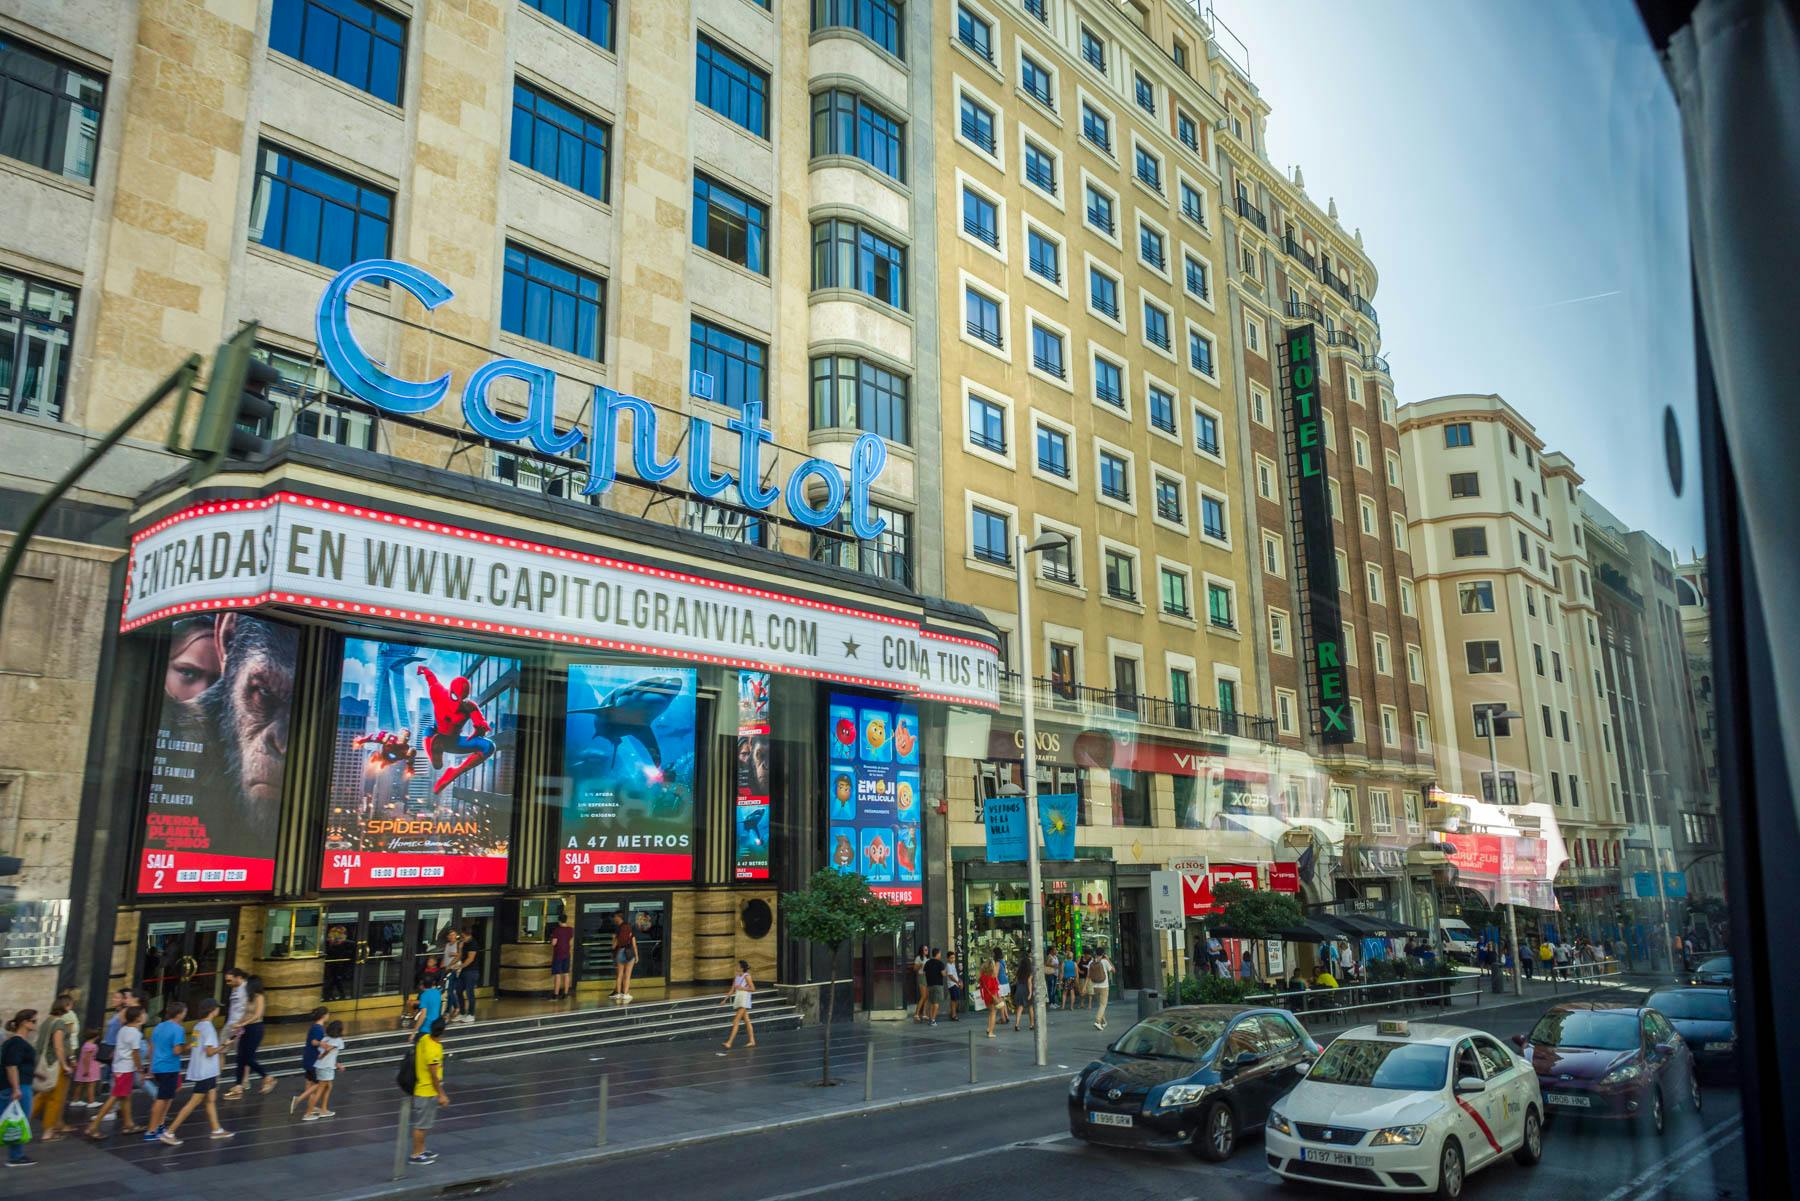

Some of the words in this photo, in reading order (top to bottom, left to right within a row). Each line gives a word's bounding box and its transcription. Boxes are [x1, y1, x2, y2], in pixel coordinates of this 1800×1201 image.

[315, 258, 888, 541] Capitol
[1291, 334, 1321, 478] HOTEL
[1317, 640, 1346, 732] REX
[139, 525, 272, 599] ENTRADAS
[287, 524, 346, 580] EN
[364, 538, 818, 657] WWW.CAPITOLGRANVIA.COM
[937, 651, 970, 686] TUS
[1015, 729, 1060, 751] GNOS
[164, 767, 195, 778] FAMILIA
[161, 794, 193, 805] PLANETA
[567, 835, 578, 848] A
[587, 836, 608, 848] 47
[617, 834, 689, 847] METROS
[147, 854, 174, 869] SALA
[333, 855, 361, 868] SALA
[565, 853, 590, 864] SALA
[153, 870, 165, 889] 2
[343, 869, 350, 885] 1
[573, 865, 581, 879] 3
